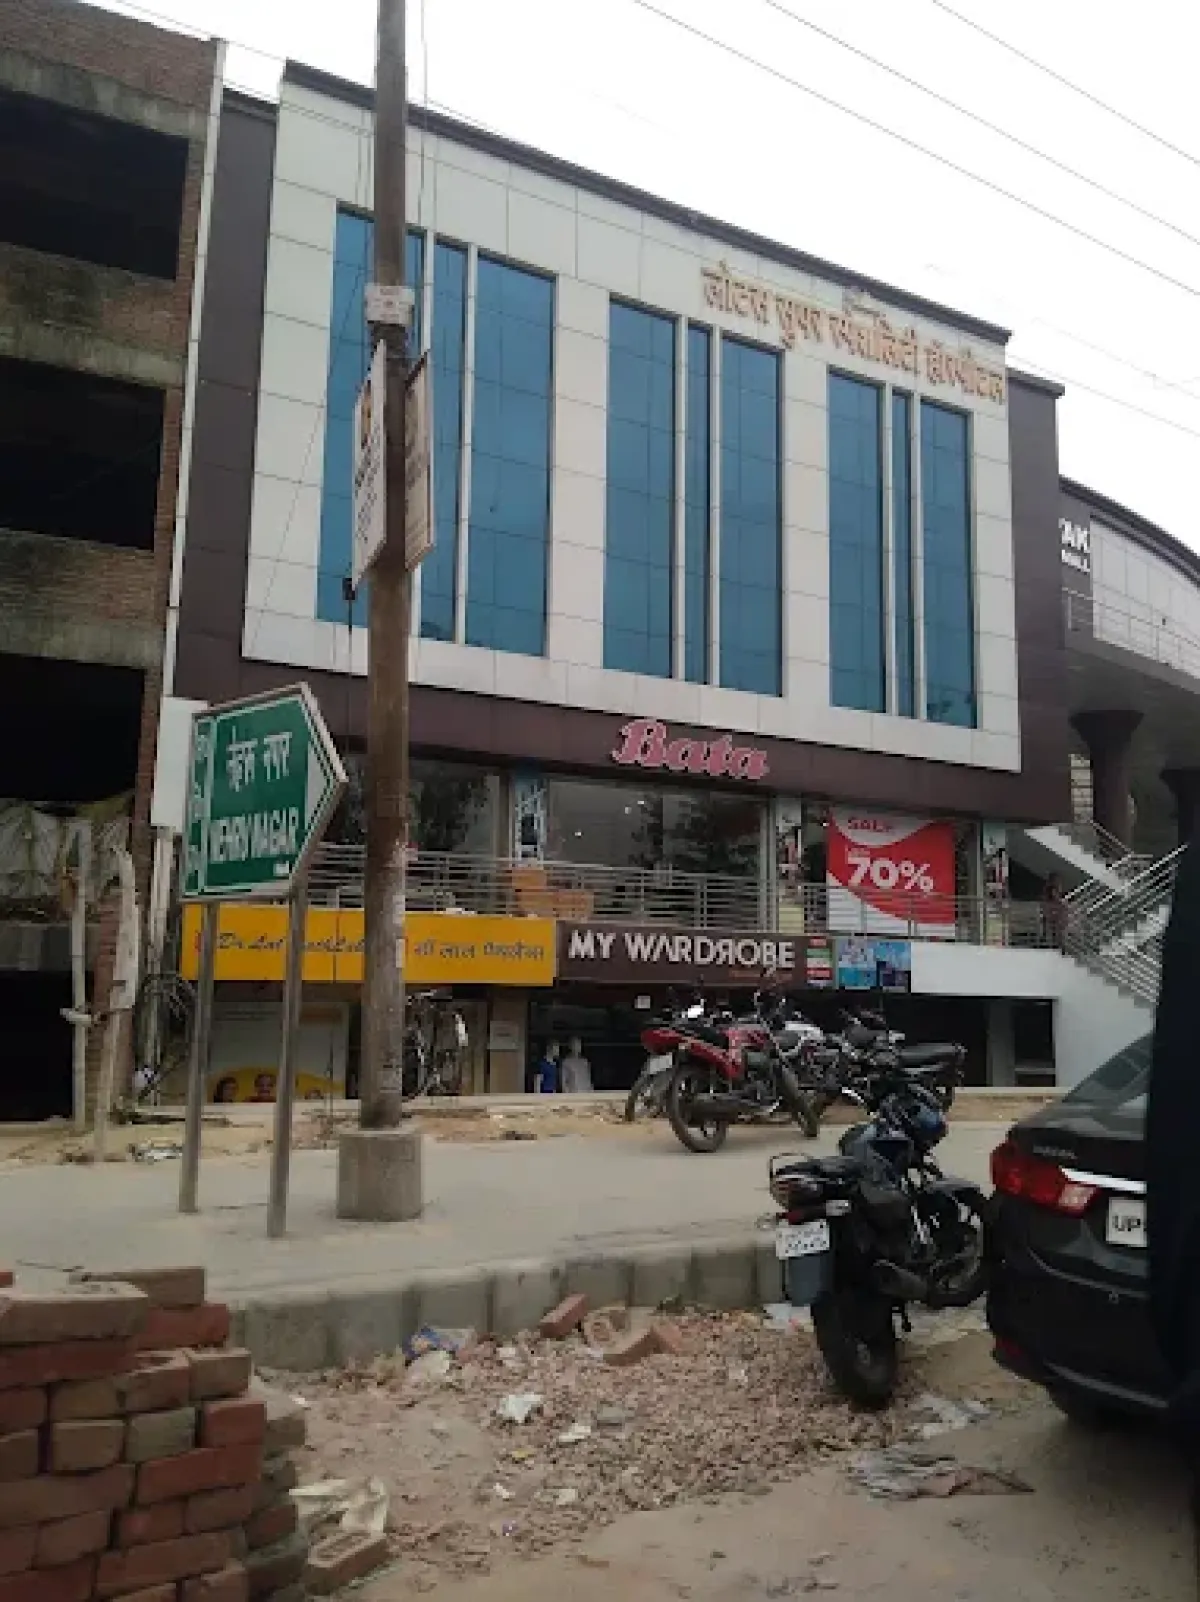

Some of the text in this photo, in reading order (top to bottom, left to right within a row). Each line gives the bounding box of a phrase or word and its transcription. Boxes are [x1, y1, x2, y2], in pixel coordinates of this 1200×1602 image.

[612, 717, 770, 780] Bata
[847, 855, 935, 893] 70%
[567, 929, 617, 960] MY
[624, 931, 796, 969] WARDROBE
